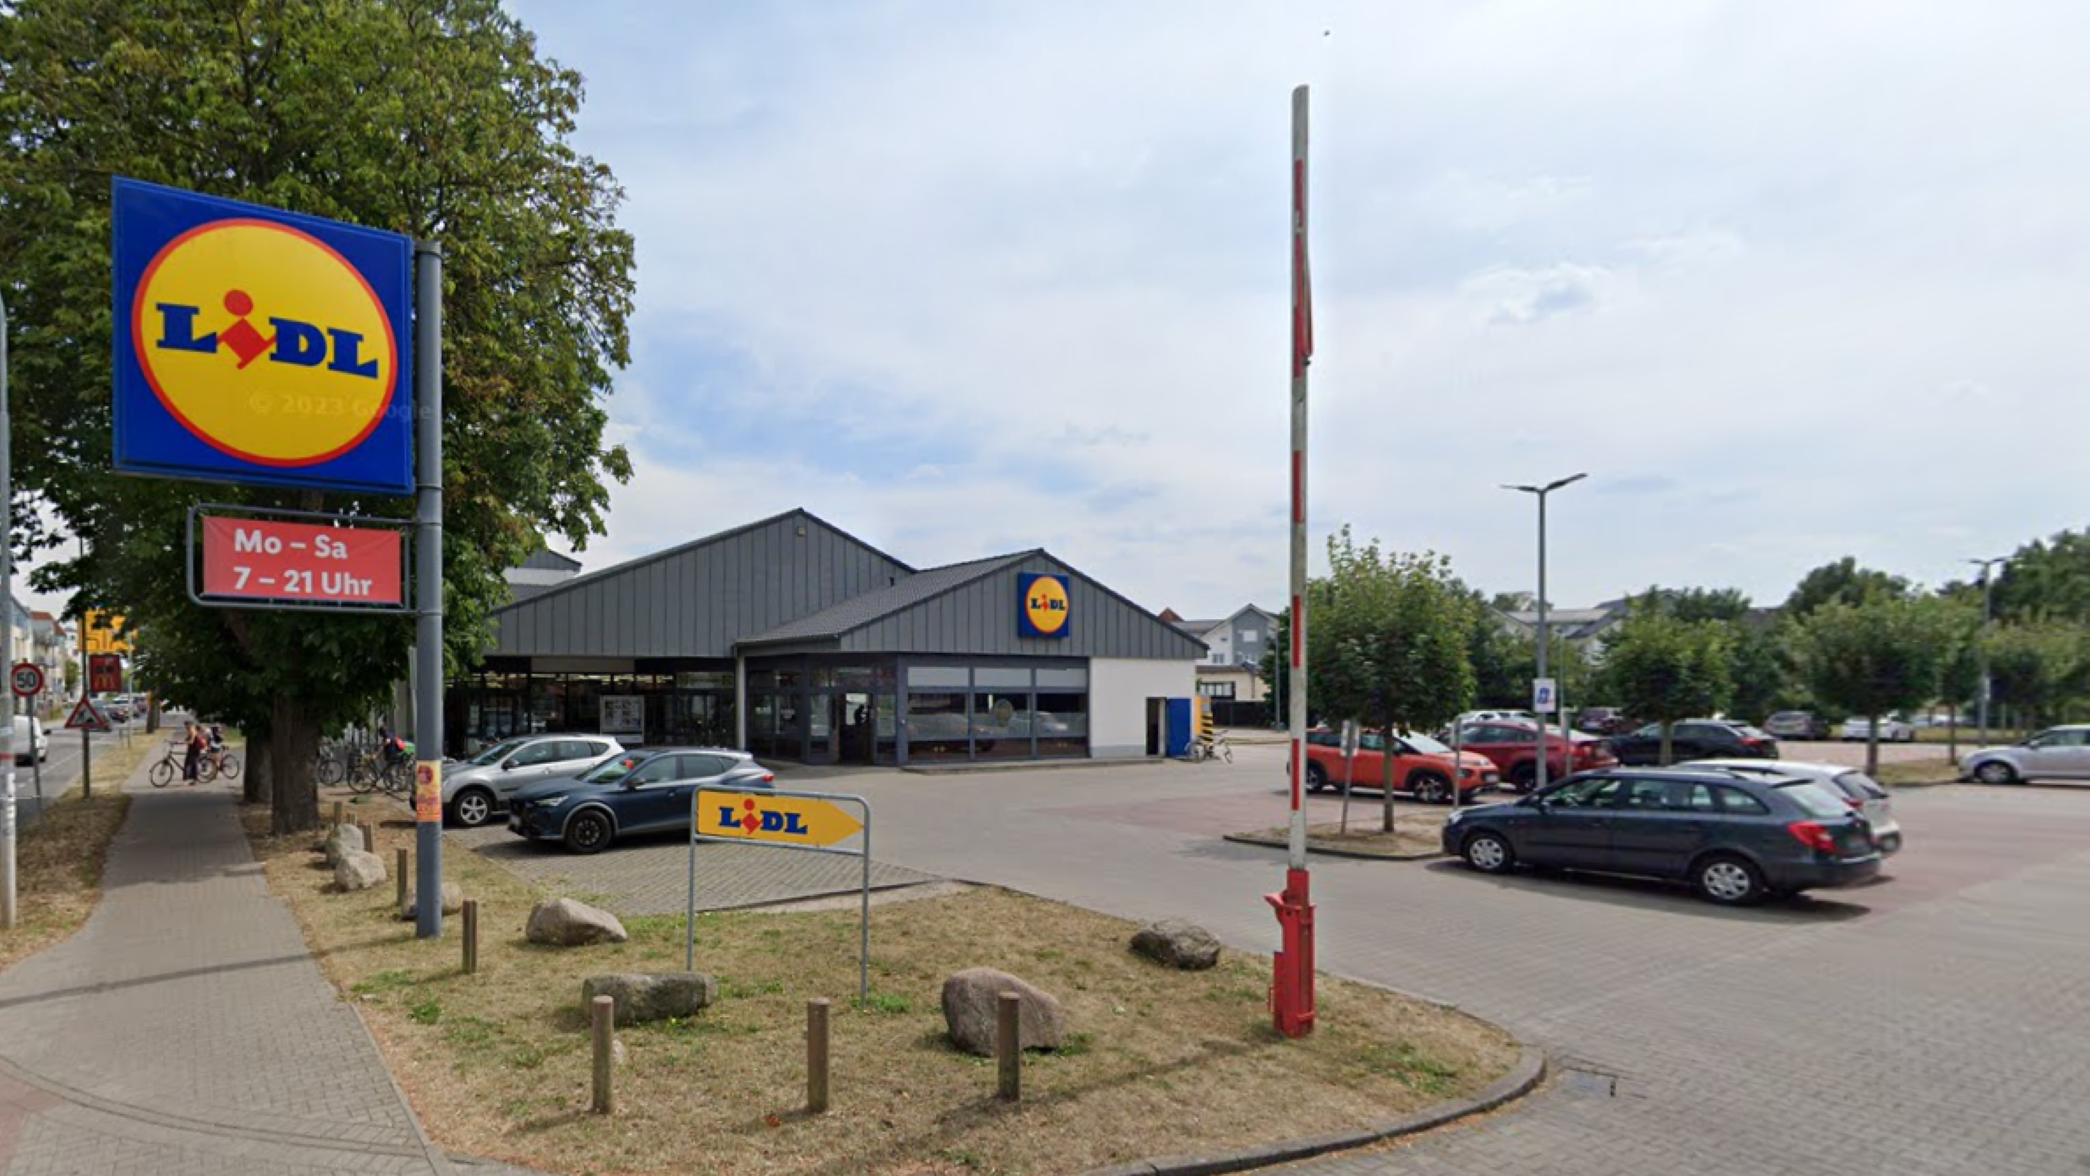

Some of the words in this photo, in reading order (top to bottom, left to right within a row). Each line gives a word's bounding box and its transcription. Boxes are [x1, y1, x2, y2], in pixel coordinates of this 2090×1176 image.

[234, 528, 282, 555] Mo
[314, 534, 348, 560] Sa
[233, 566, 251, 590] 7
[283, 569, 313, 594] 21
[321, 571, 373, 596] Uhr
[16, 671, 37, 689] 50
